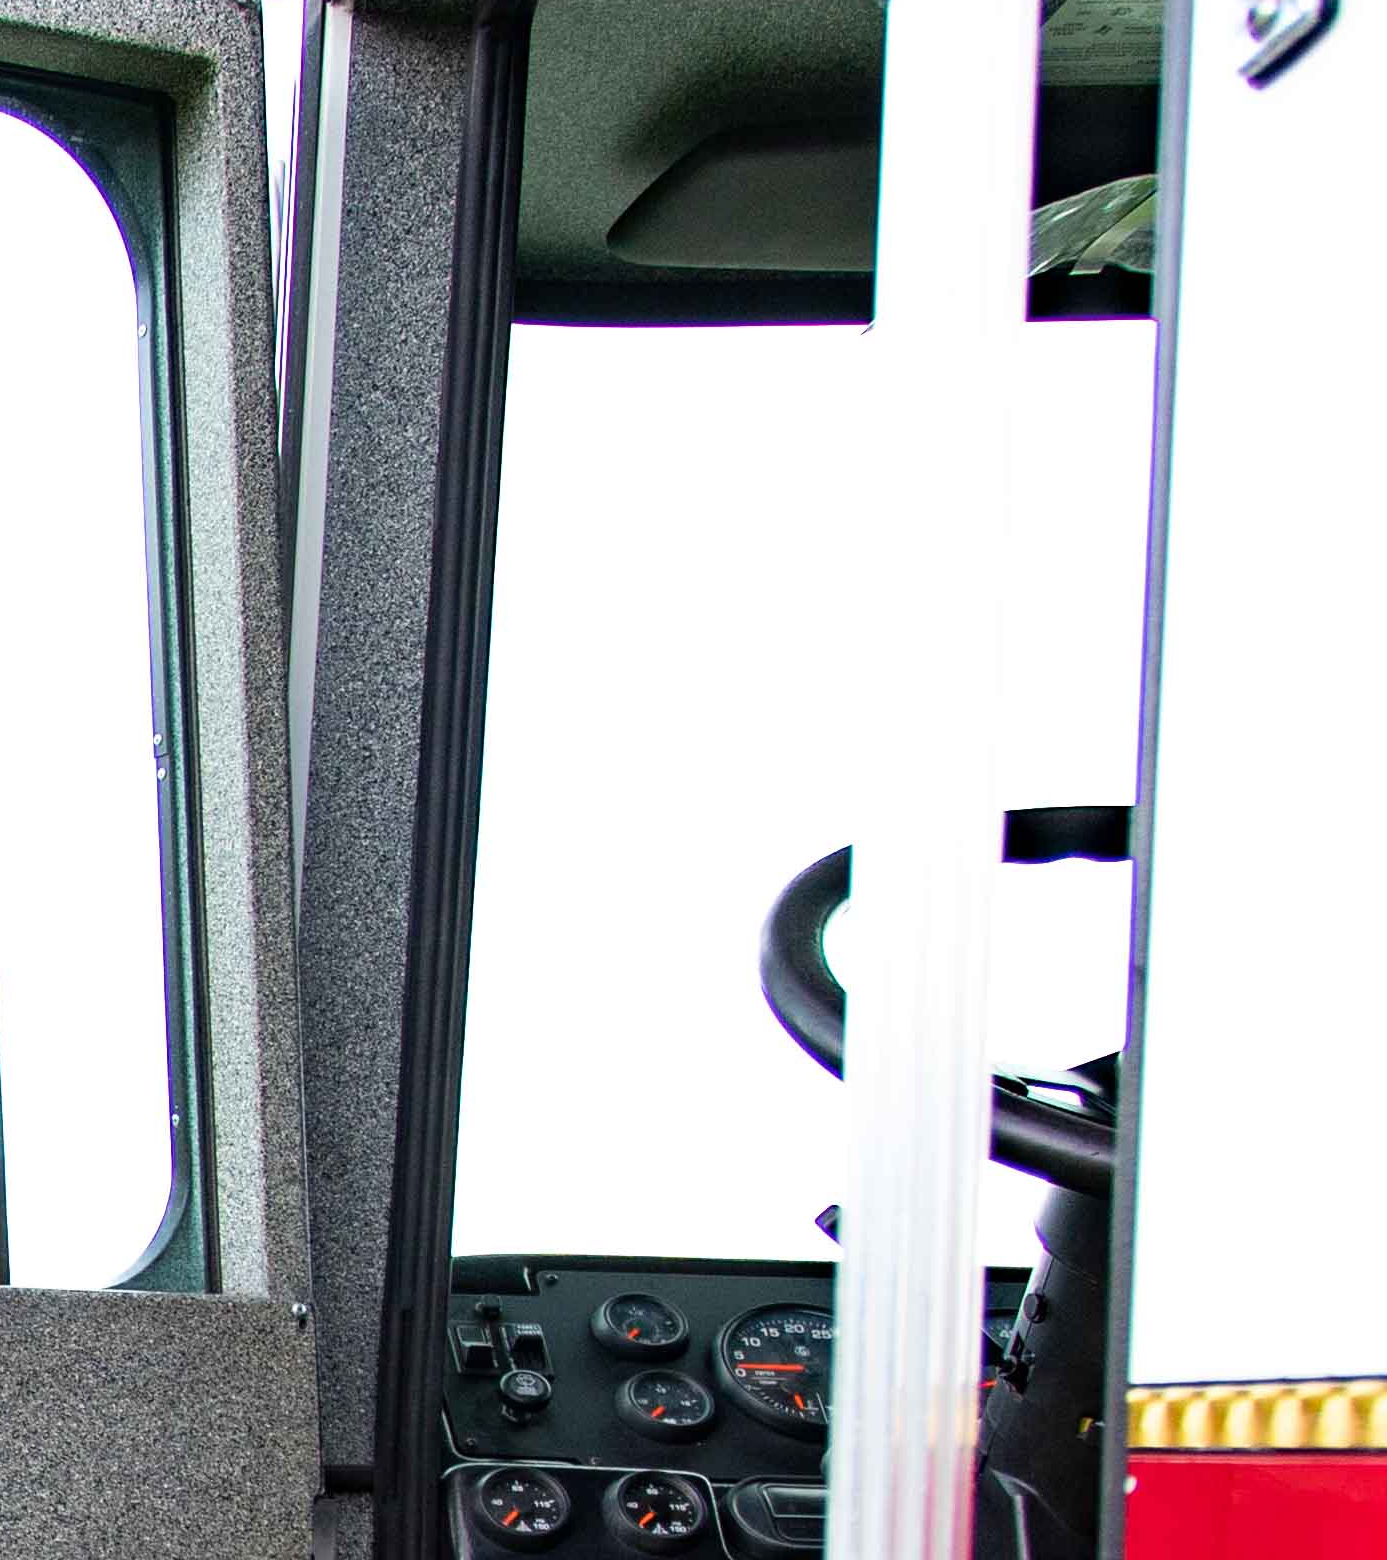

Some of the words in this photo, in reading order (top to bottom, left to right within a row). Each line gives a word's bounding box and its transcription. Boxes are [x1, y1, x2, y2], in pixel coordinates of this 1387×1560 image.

[760, 1327, 779, 1338] 15
[784, 1323, 804, 1334] 20
[811, 1329, 832, 1339] 25
[740, 1337, 761, 1347] 10
[734, 1350, 744, 1360] 5
[735, 1367, 746, 1377] 0
